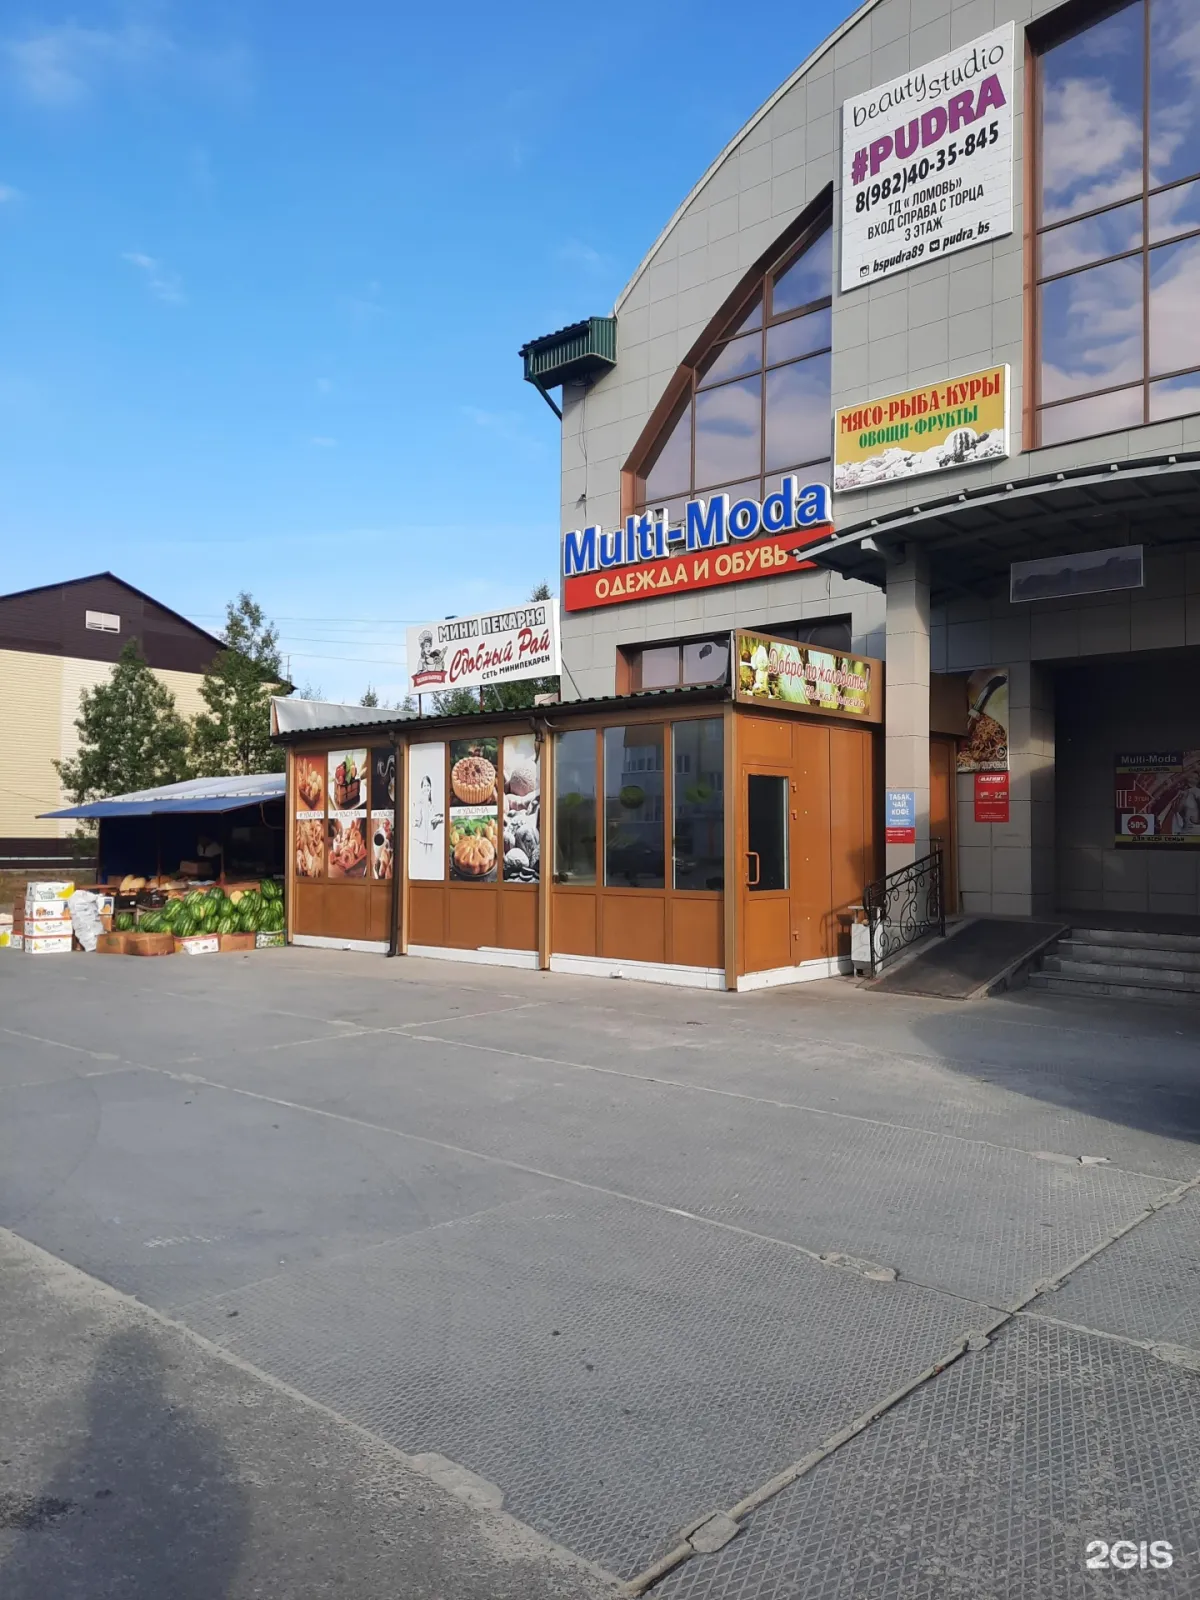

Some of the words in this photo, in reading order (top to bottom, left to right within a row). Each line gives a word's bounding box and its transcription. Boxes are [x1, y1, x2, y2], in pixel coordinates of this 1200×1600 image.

[851, 73, 1007, 186] #PUDRA
[855, 120, 999, 213] 8(982)40-35-845
[868, 218, 895, 239] ВХОД
[897, 202, 937, 228] СПРАВА
[940, 198, 946, 212] С
[949, 184, 984, 208] ТОРЦА
[888, 200, 901, 216] ТД
[904, 228, 911, 241] 3
[913, 216, 943, 238] ЭТАЖ
[873, 243, 925, 272] bspudra89
[942, 221, 990, 251] pudra_bs
[564, 473, 834, 577] Multi-Moda
[595, 566, 688, 599] ОДЕЖДА
[693, 558, 709, 581] И
[715, 544, 789, 576] ОБУВЬ
[438, 619, 479, 643] МИНИ
[481, 606, 546, 635] ПЕКАРНЯ
[450, 640, 513, 683] Сдобный
[517, 628, 551, 660] Рай
[481, 668, 498, 680] СЕТЬ
[499, 655, 551, 676] МИНИПЕКАРЕН
[767, 648, 804, 686] Добро
[1121, 755, 1177, 764] Multi-Moda
[1128, 821, 1146, 829] -50%
